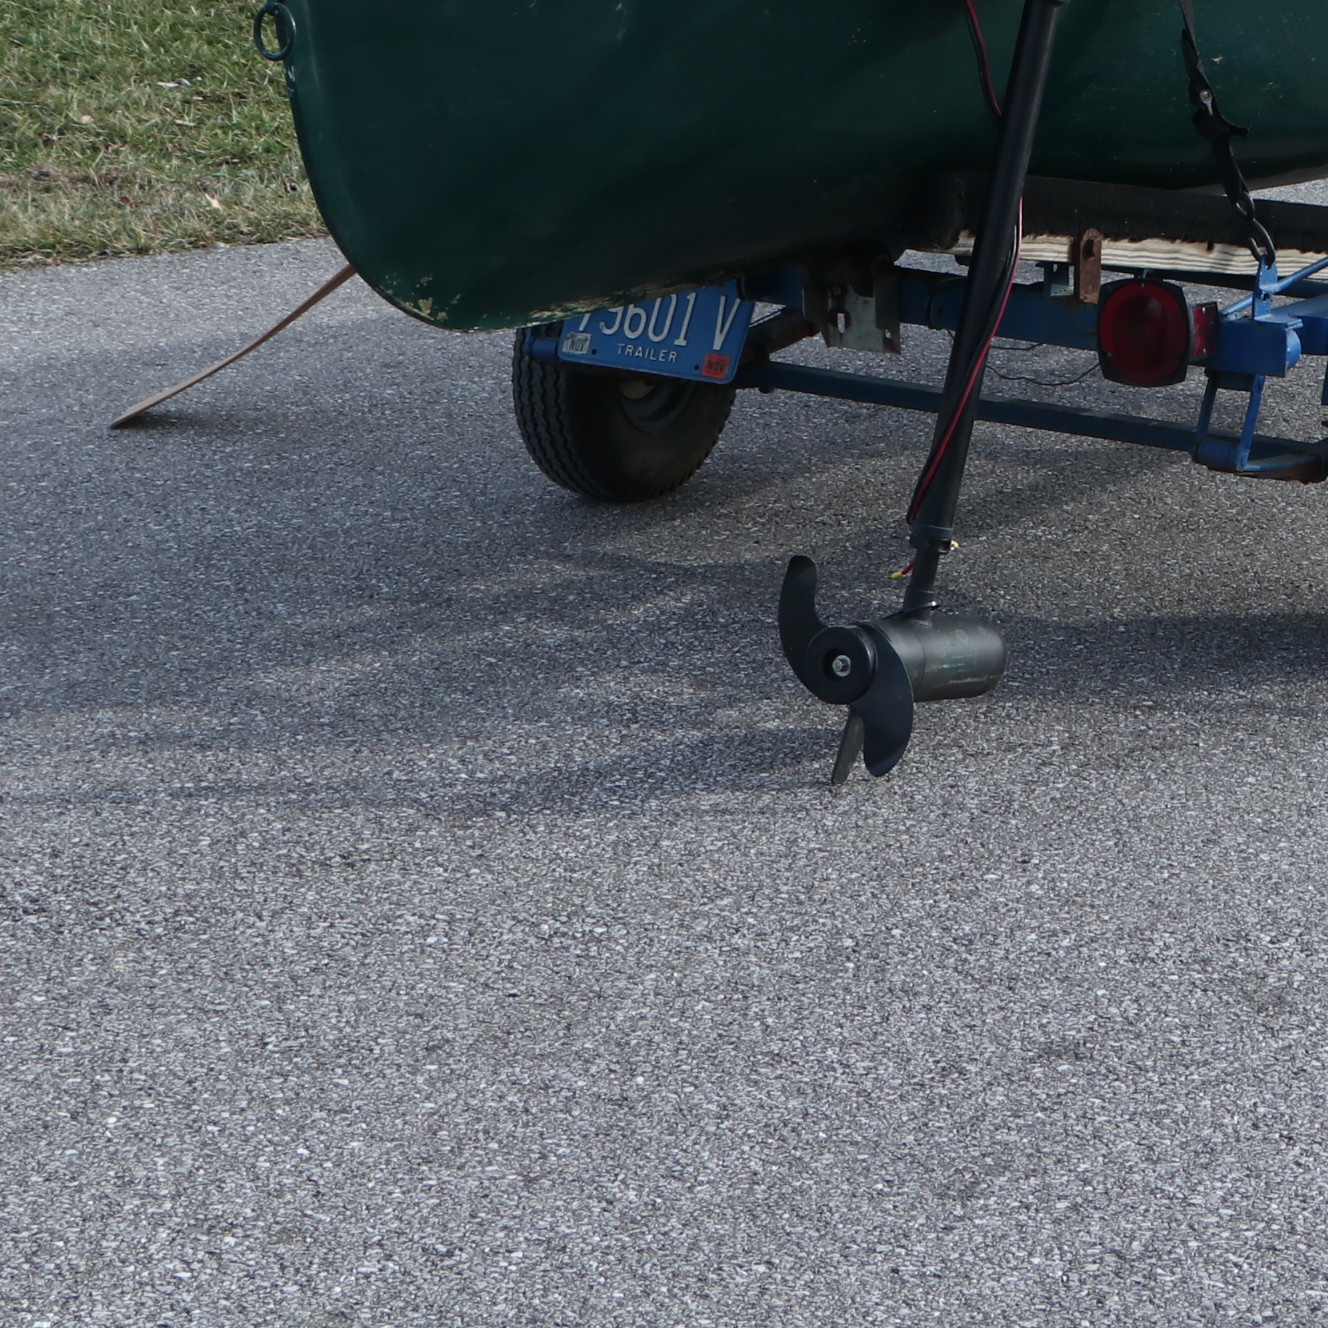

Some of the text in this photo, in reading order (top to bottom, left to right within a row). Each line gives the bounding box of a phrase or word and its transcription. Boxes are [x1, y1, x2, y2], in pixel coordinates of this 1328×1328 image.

[713, 295, 741, 351] V
[617, 343, 678, 363] TRAILER
[706, 359, 726, 373] NOV
